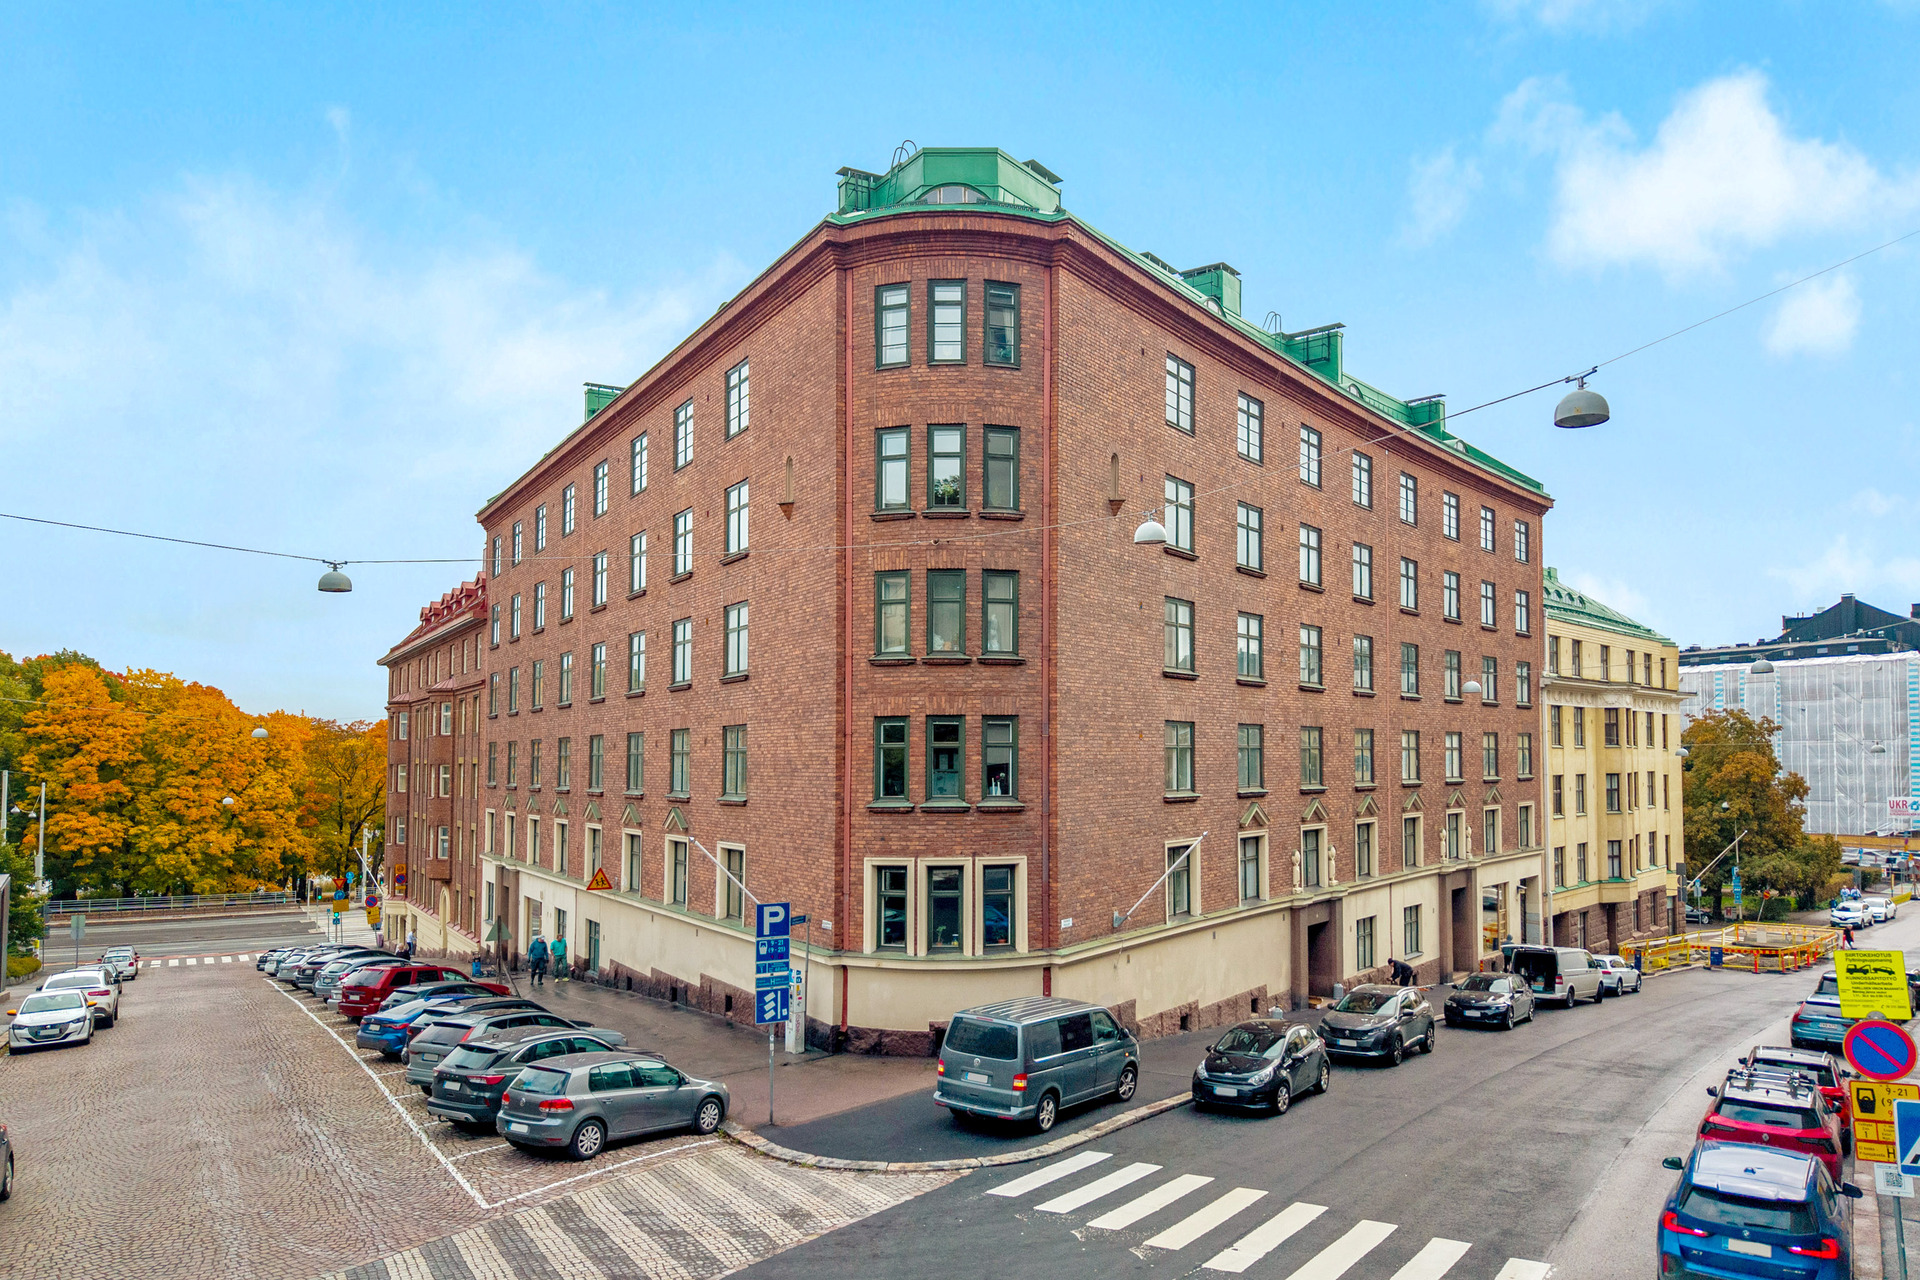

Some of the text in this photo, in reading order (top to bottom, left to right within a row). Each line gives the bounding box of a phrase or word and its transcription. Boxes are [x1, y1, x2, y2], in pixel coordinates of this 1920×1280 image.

[1889, 799, 1908, 809] UKR
[763, 905, 785, 935] P
[1886, 1087, 1908, 1097] 9-21
[1887, 1147, 1896, 1159] H
